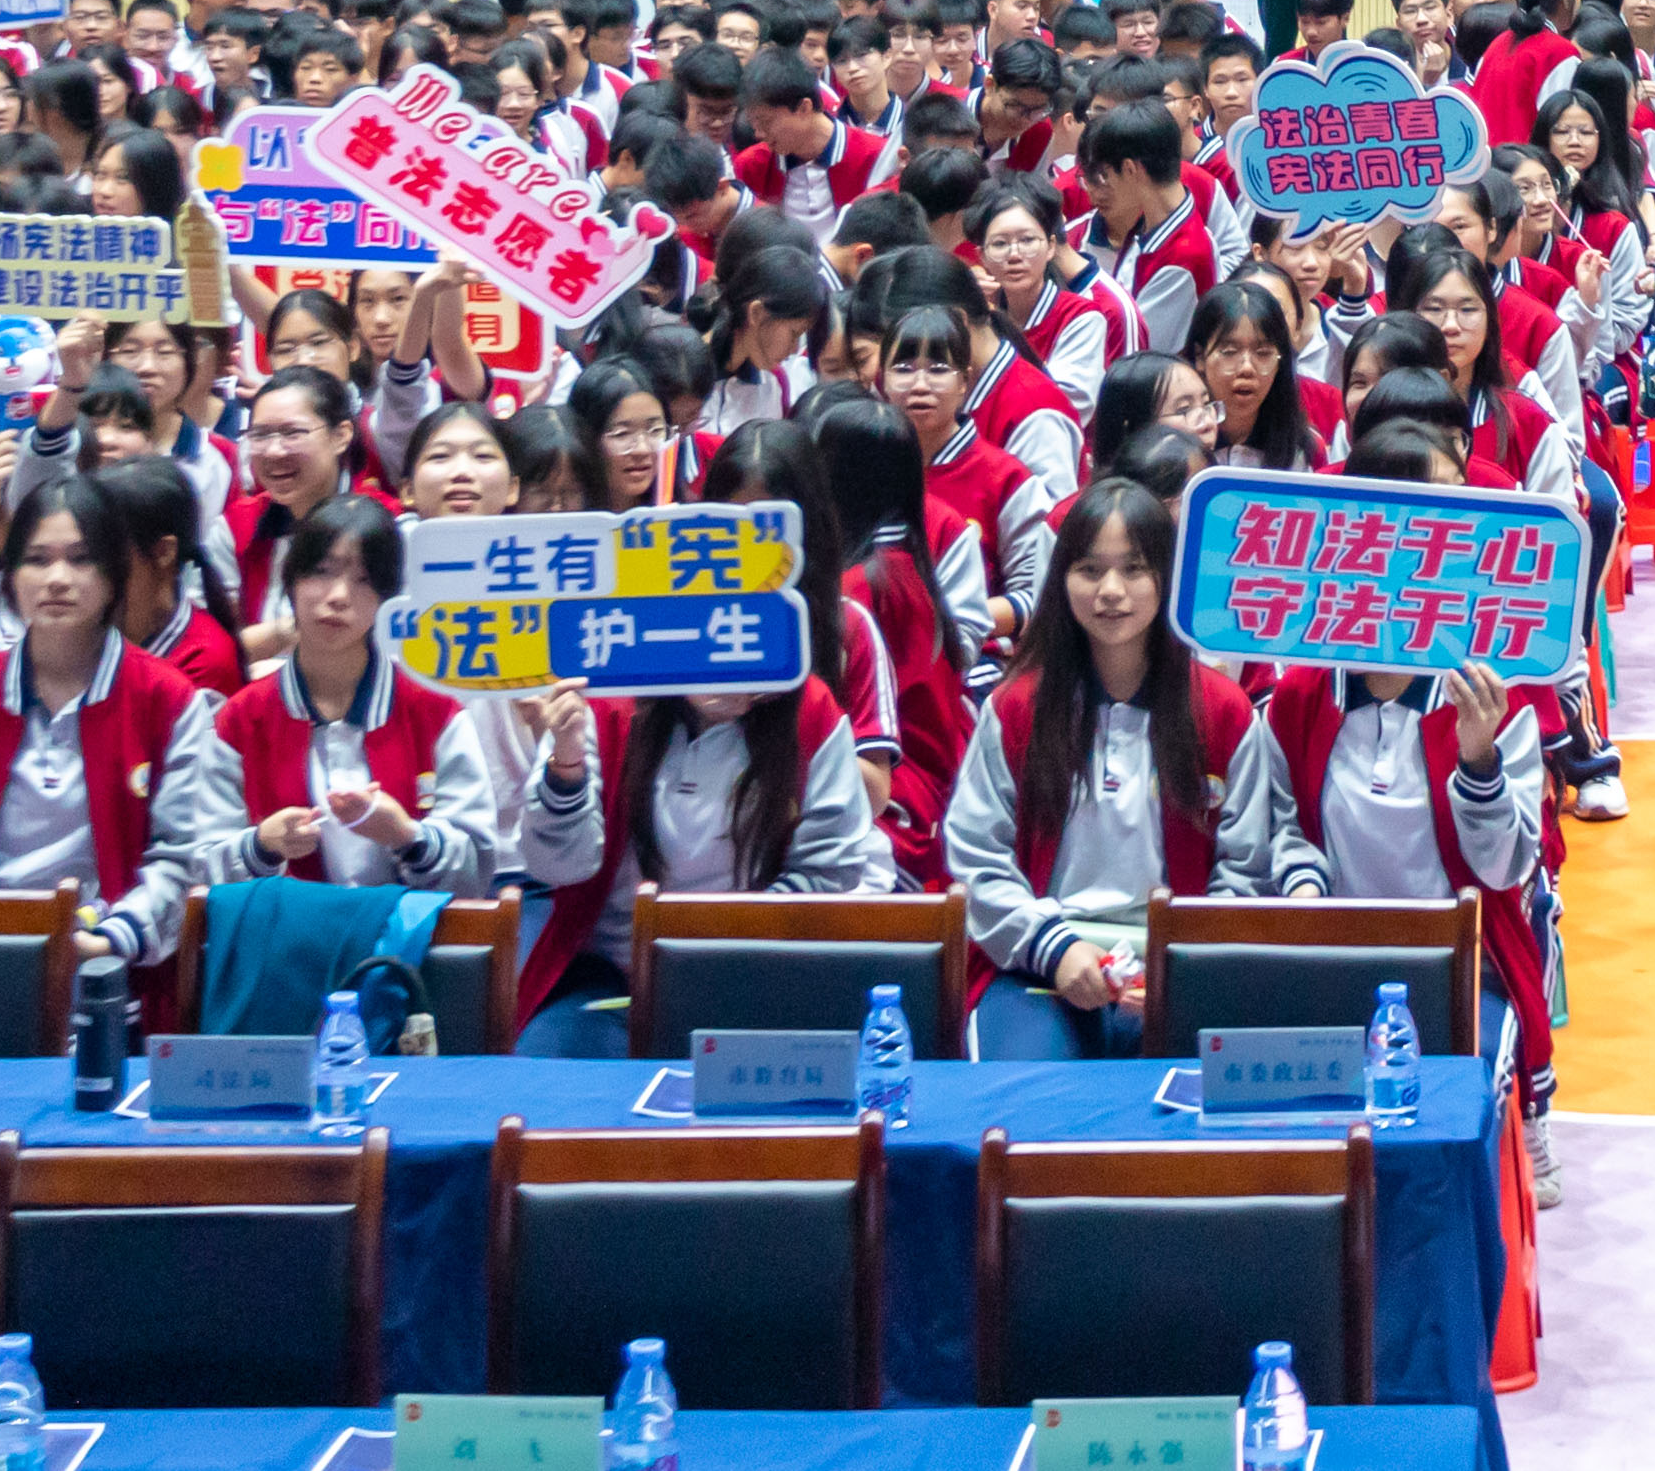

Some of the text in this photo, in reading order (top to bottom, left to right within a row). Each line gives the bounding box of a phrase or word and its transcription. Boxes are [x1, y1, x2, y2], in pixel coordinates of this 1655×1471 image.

[394, 72, 592, 222] We are
[1258, 98, 1440, 149] 法治青春
[342, 114, 604, 306] 普法志愿者
[1266, 144, 1445, 195] 宪法同行
[1229, 503, 1557, 587] 知法于心
[1227, 576, 1548, 660] 守法于行
